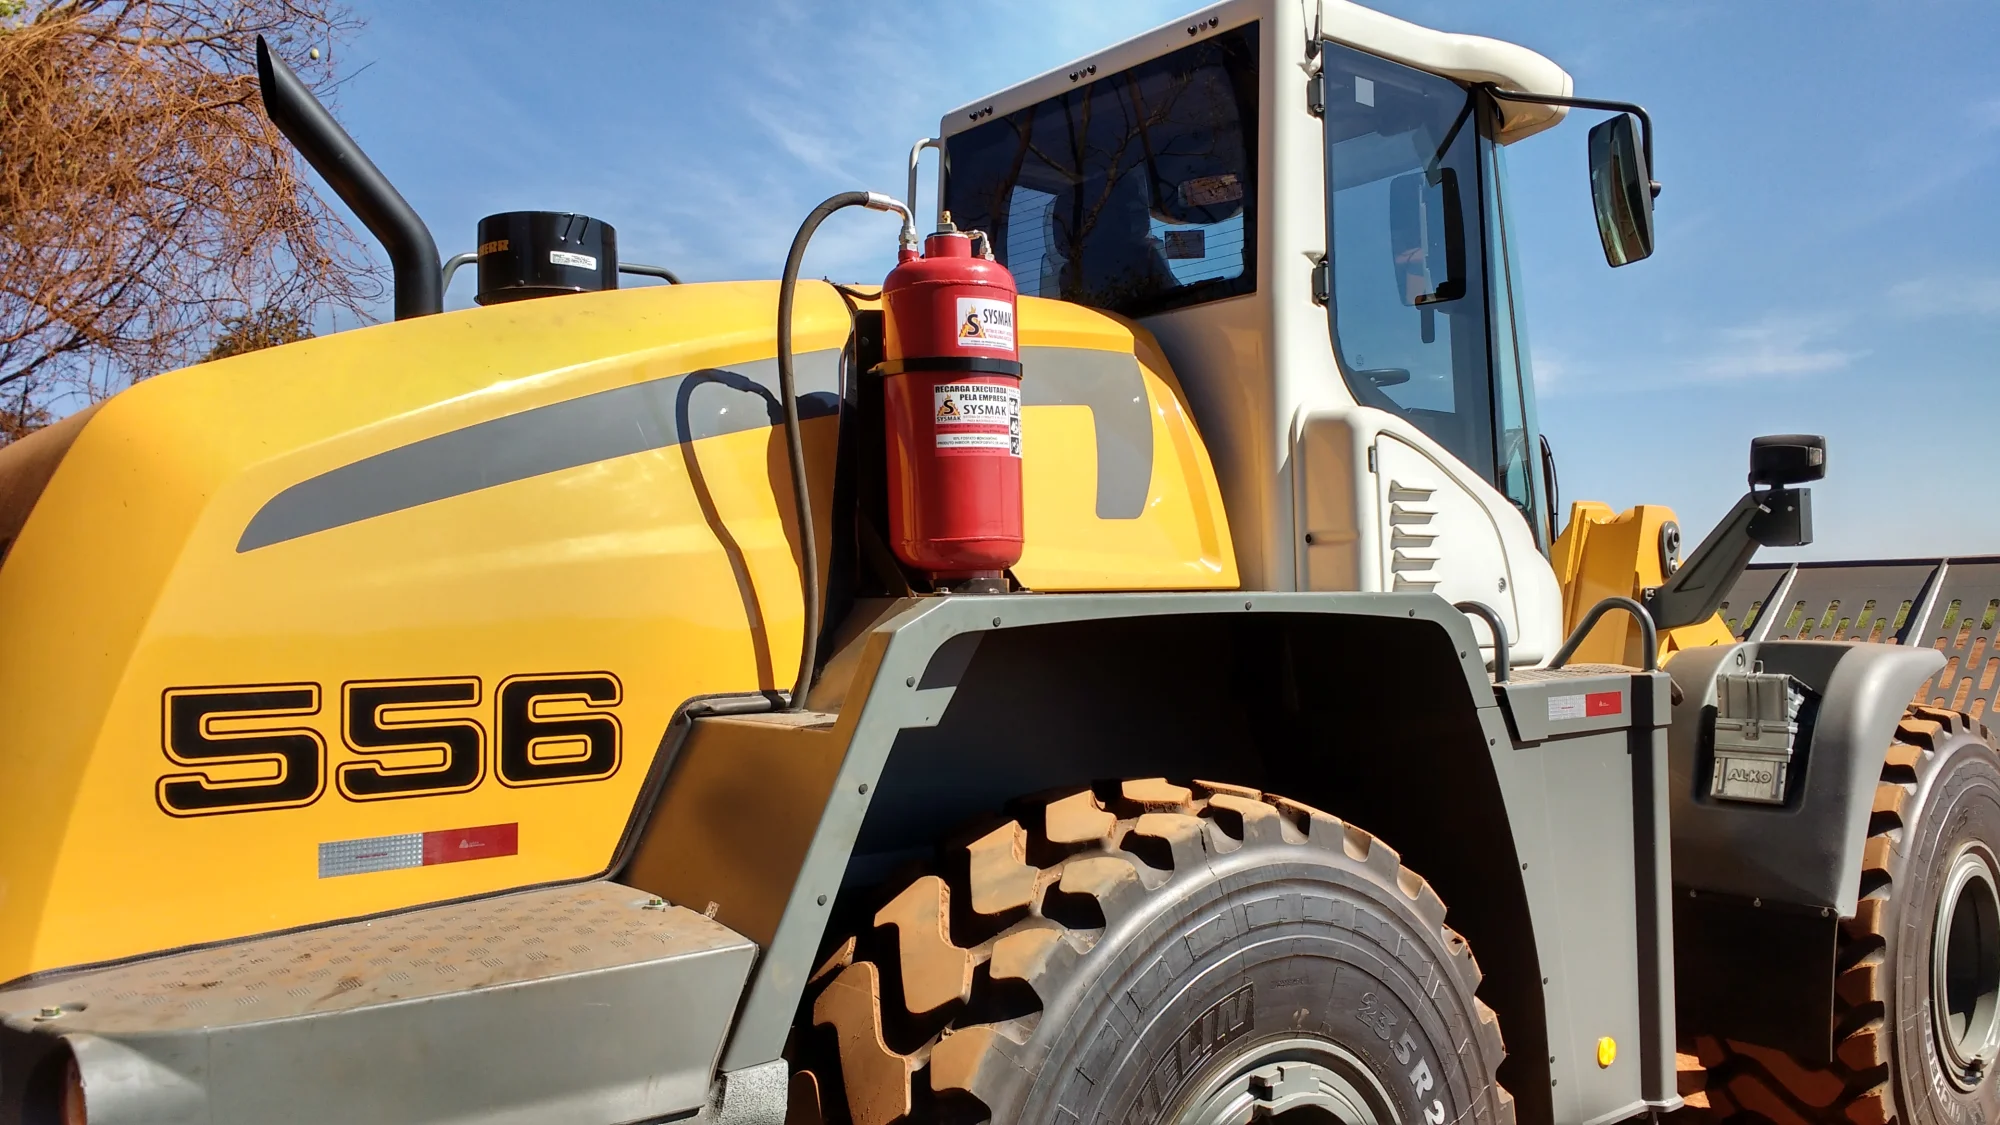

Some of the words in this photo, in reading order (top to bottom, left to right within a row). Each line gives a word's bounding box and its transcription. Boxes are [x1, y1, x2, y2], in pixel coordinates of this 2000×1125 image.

[983, 308, 1012, 328] SYSMAK
[935, 385, 970, 393] RECARGA
[972, 386, 1007, 394] EXECUTADA
[979, 394, 1007, 402] EMPRESA
[963, 404, 1007, 416] SYSMAK
[155, 670, 623, 819] 556
